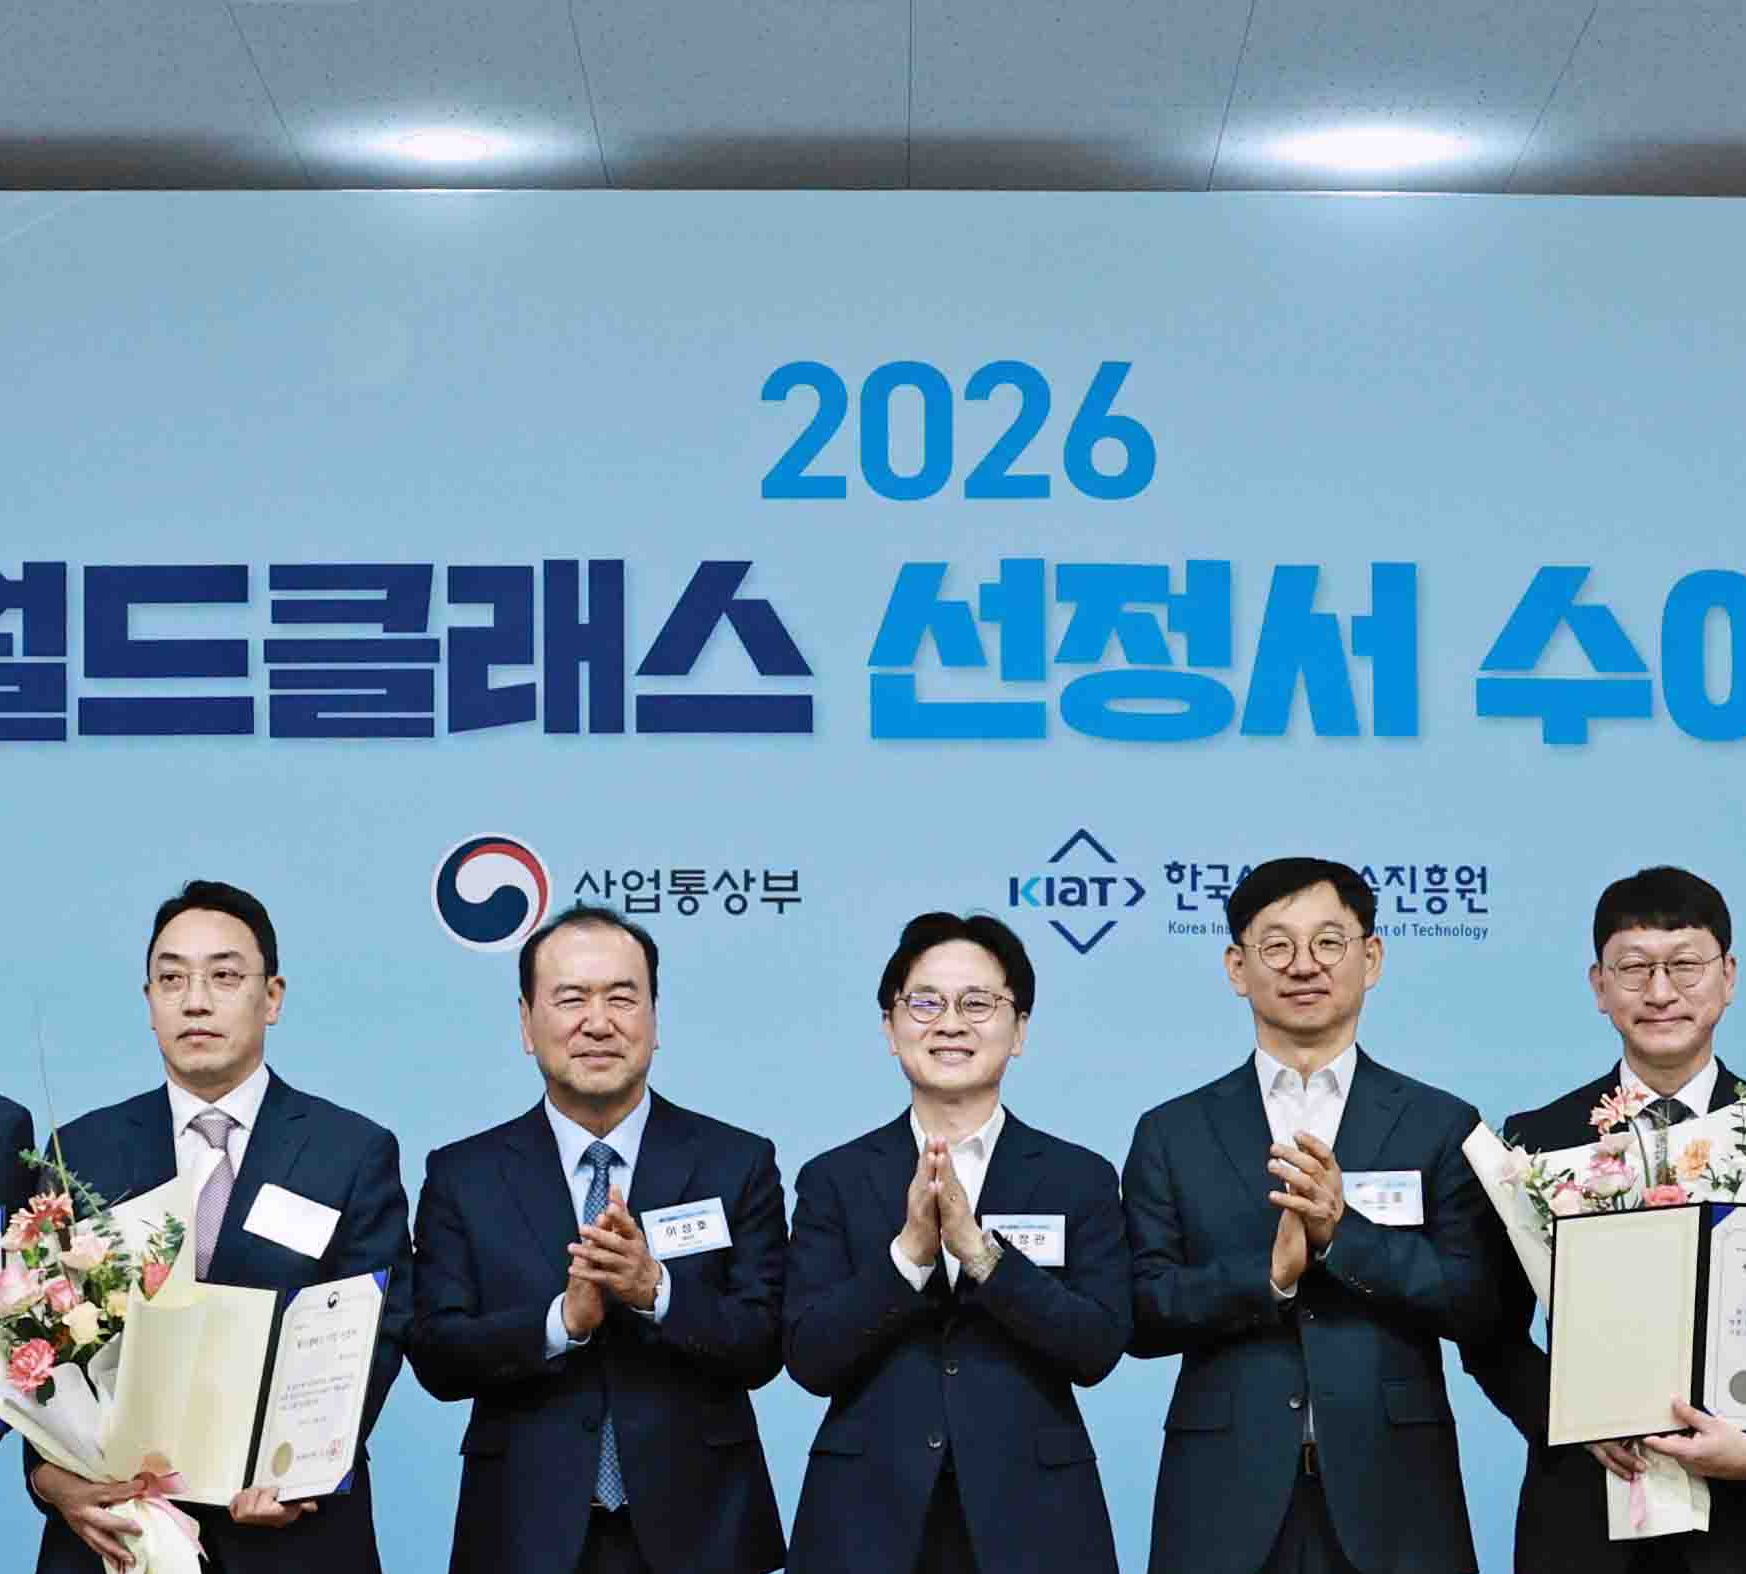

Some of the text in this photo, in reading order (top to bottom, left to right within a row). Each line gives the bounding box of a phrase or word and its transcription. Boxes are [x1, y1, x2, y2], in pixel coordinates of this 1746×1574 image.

[762, 361, 1156, 501] 2026
[867, 558, 1420, 743] 선정서
[574, 868, 803, 917] 산업통상부
[1163, 860, 1489, 916] 한국진흥원
[1168, 919, 1207, 935] Korea
[1393, 923, 1406, 937] of
[1411, 922, 1489, 941] Technology
